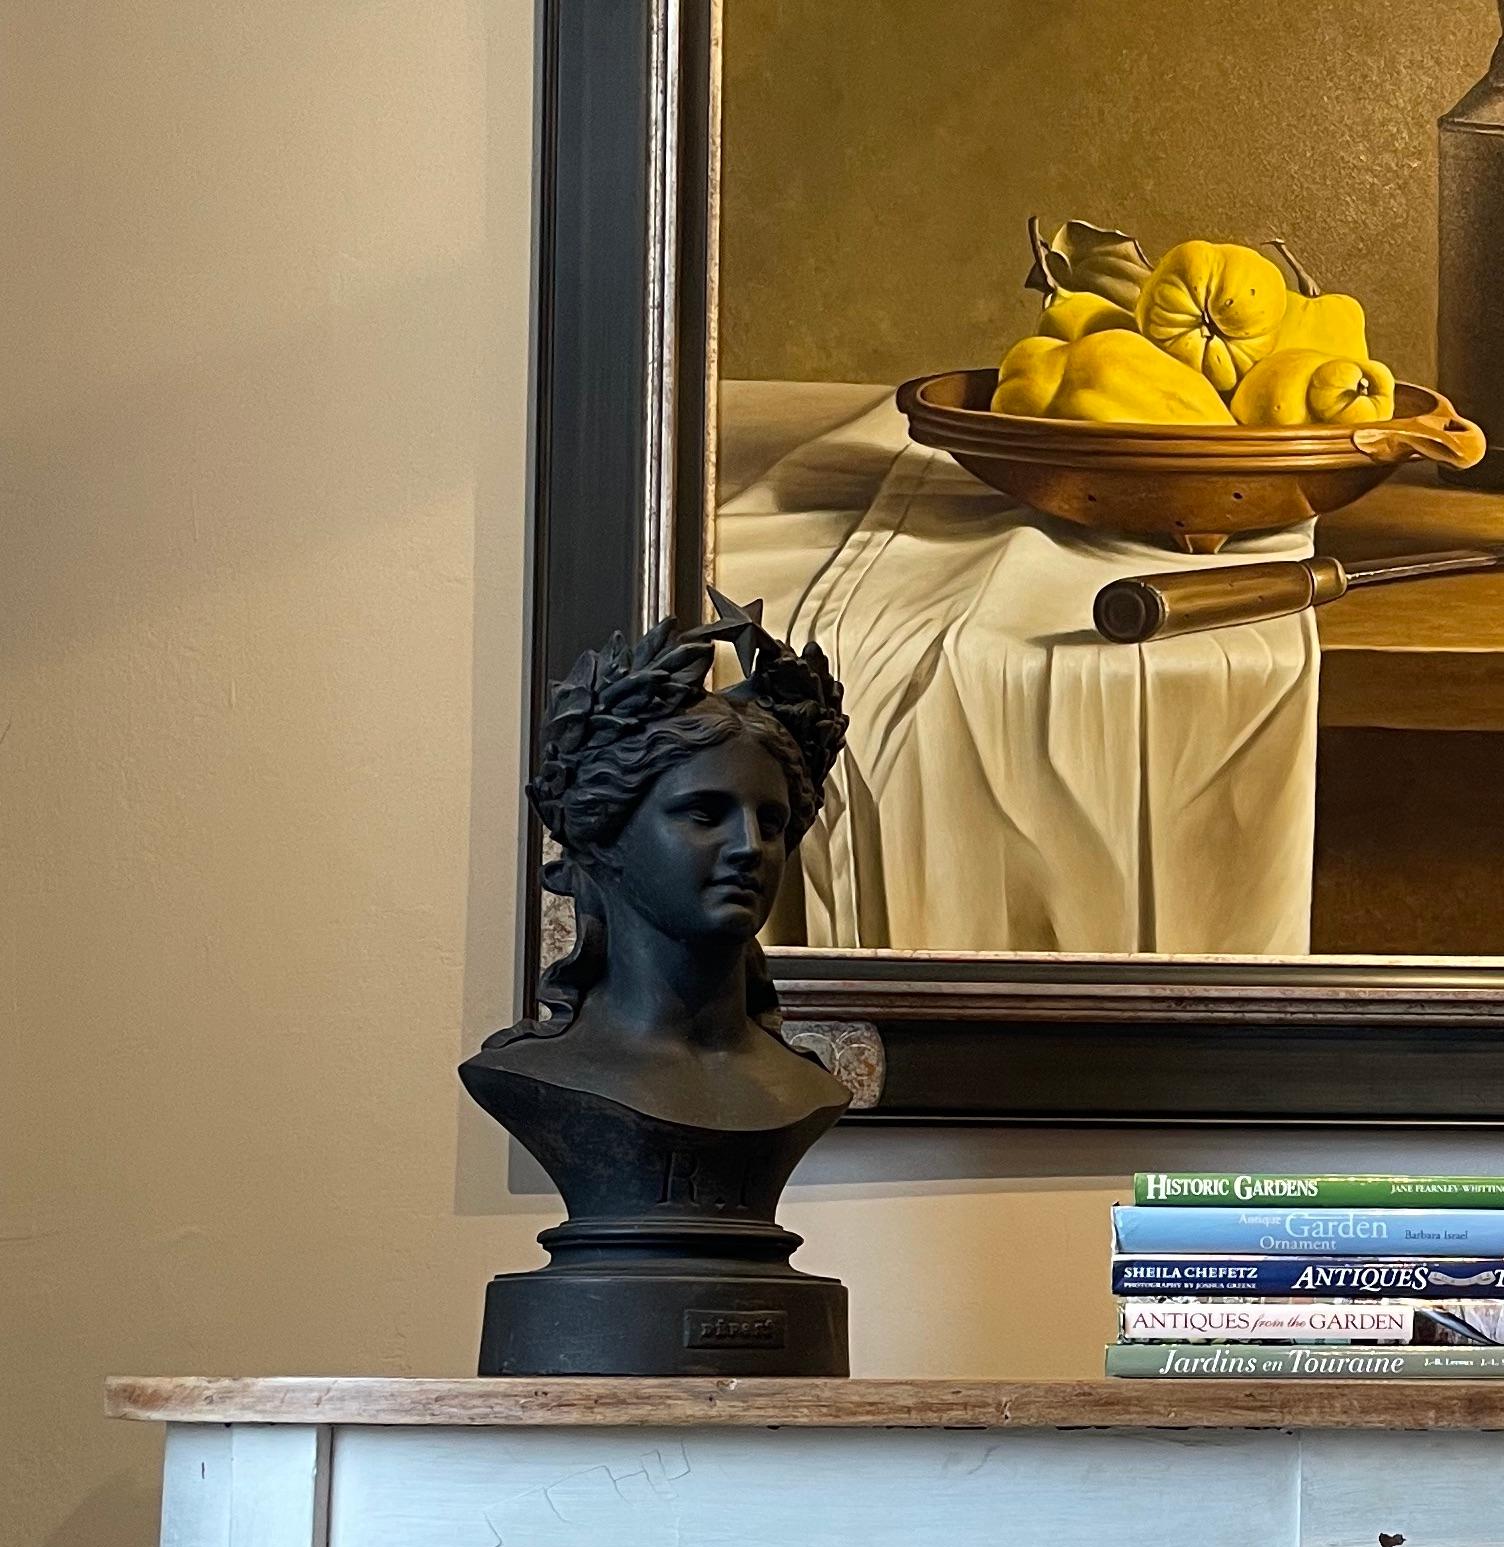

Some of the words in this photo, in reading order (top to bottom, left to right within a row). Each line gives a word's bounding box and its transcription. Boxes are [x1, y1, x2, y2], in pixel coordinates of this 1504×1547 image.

[1146, 1174, 1229, 1200] HISTORIC
[1234, 1175, 1318, 1200] GARDENS
[1391, 1184, 1413, 1194] JANE
[1238, 1214, 1282, 1226] Antique
[1285, 1213, 1389, 1239] Garden
[1260, 1236, 1337, 1250] Ornament
[1405, 1230, 1441, 1240] Barbara
[1444, 1230, 1468, 1240] Israel
[1123, 1267, 1182, 1278] SHEILA
[1184, 1267, 1258, 1279] CHEFETZ
[1291, 1265, 1430, 1291] ANTIQUES
[1133, 1313, 1250, 1332] ANTIQUES
[1251, 1314, 1289, 1332] from
[1287, 1313, 1306, 1328] the
[1309, 1313, 1404, 1330] GARDEN
[1159, 1349, 1256, 1375] Jardins
[1262, 1360, 1282, 1371] en
[1288, 1349, 1405, 1373] Touraine
